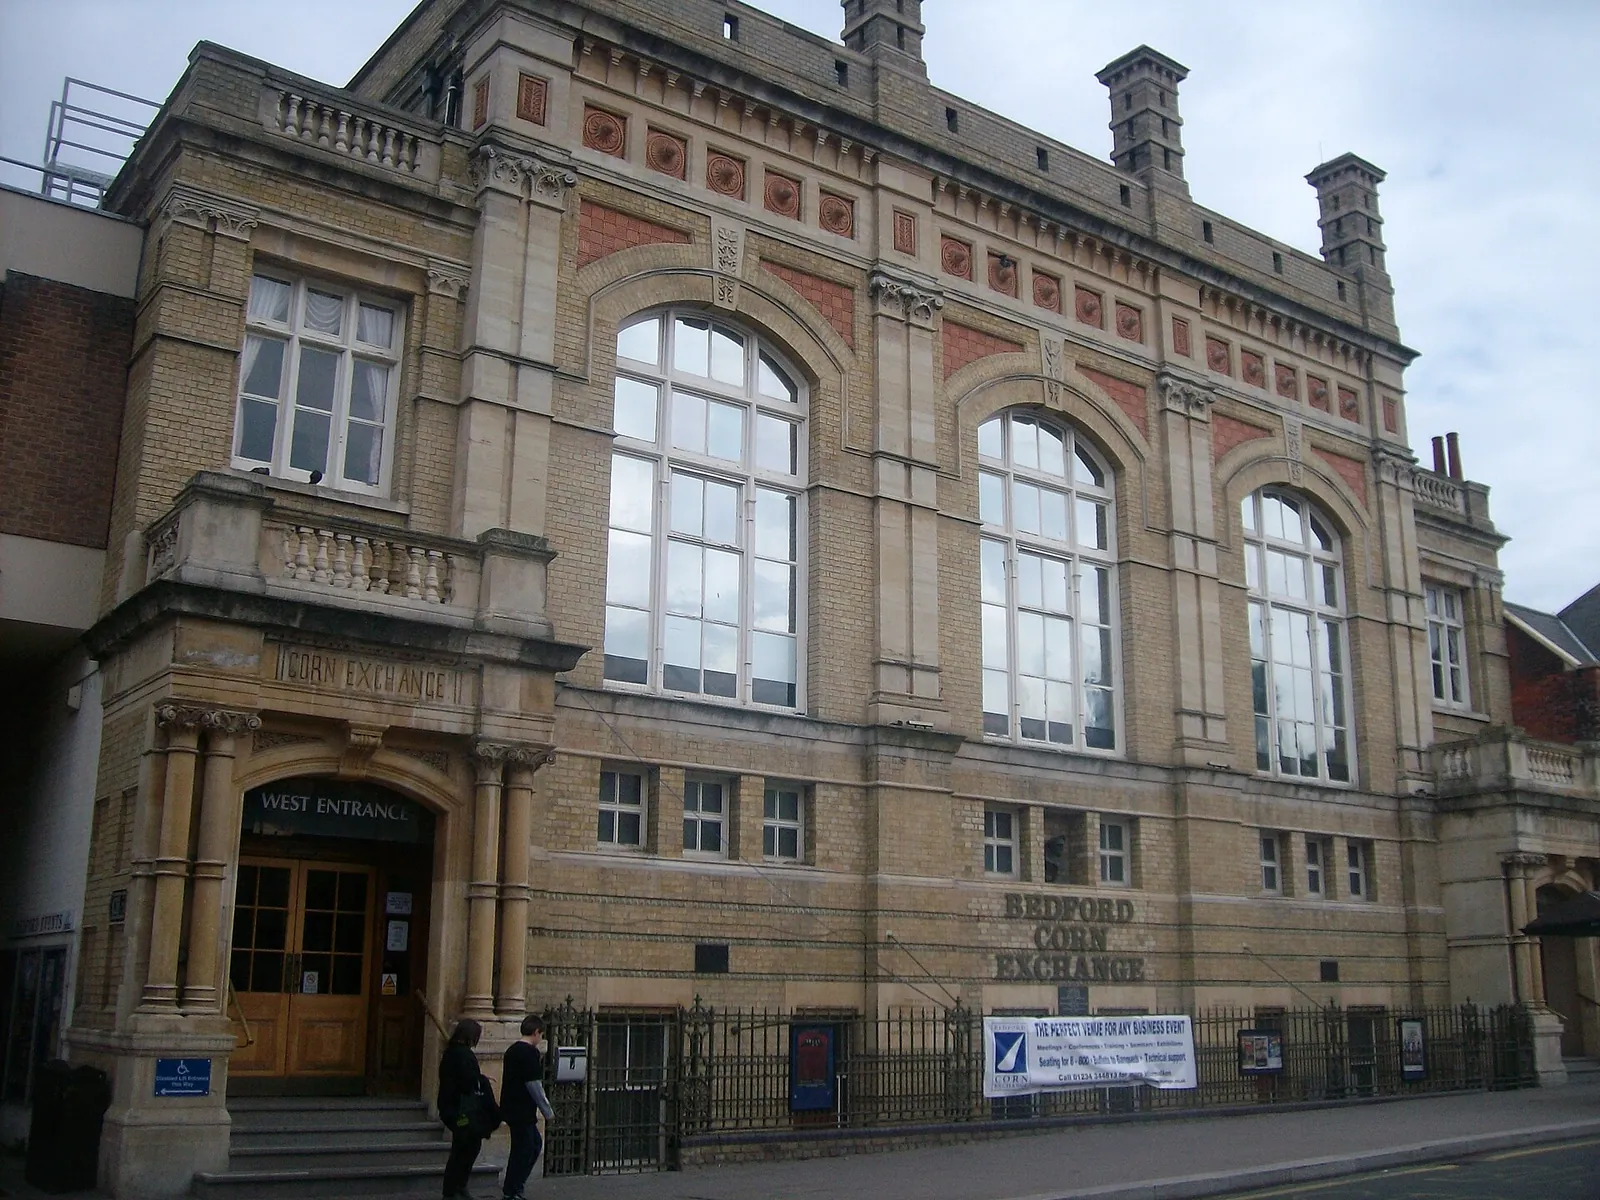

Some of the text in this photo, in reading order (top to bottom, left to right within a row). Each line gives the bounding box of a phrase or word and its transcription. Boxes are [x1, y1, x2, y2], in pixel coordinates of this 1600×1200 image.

[288, 651, 446, 700] CORN EXCHANGE
[261, 792, 409, 821] WEST ENTRANCE
[1004, 893, 1134, 923] BEDFORD
[1034, 925, 1110, 951] CORN
[995, 954, 1145, 981] EXCHANGE
[1034, 1020, 1185, 1037] THE PERFECT VENUE FOR ANY BUSINESS EVENT
[1038, 1056, 1060, 1069] Seating
[1061, 1056, 1069, 1066] for
[1144, 1053, 1167, 1062] Technical
[1168, 1053, 1186, 1064] support
[994, 1075, 1029, 1083] CORN
